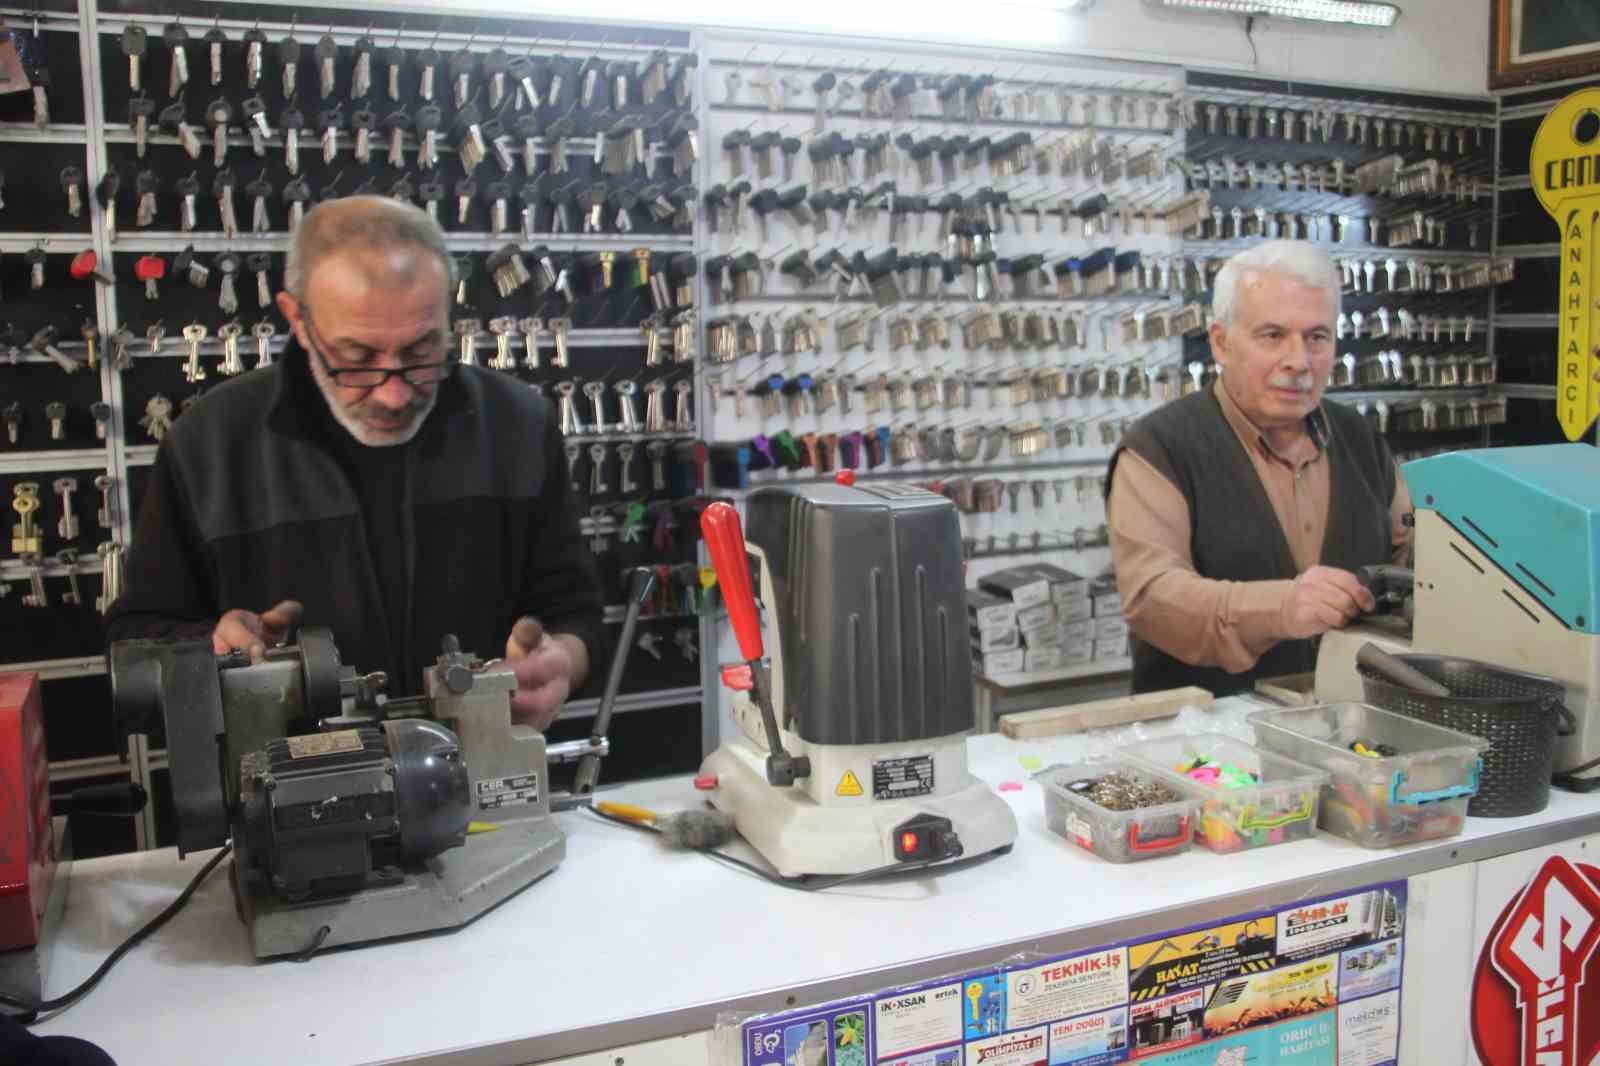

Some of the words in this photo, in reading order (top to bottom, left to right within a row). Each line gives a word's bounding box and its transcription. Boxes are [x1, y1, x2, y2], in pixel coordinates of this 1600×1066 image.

[1566, 223, 1582, 424] ANAHTARCI
[1041, 953, 1121, 982] TEKNİK-İŞ
[1156, 961, 1200, 983] HAYAT
